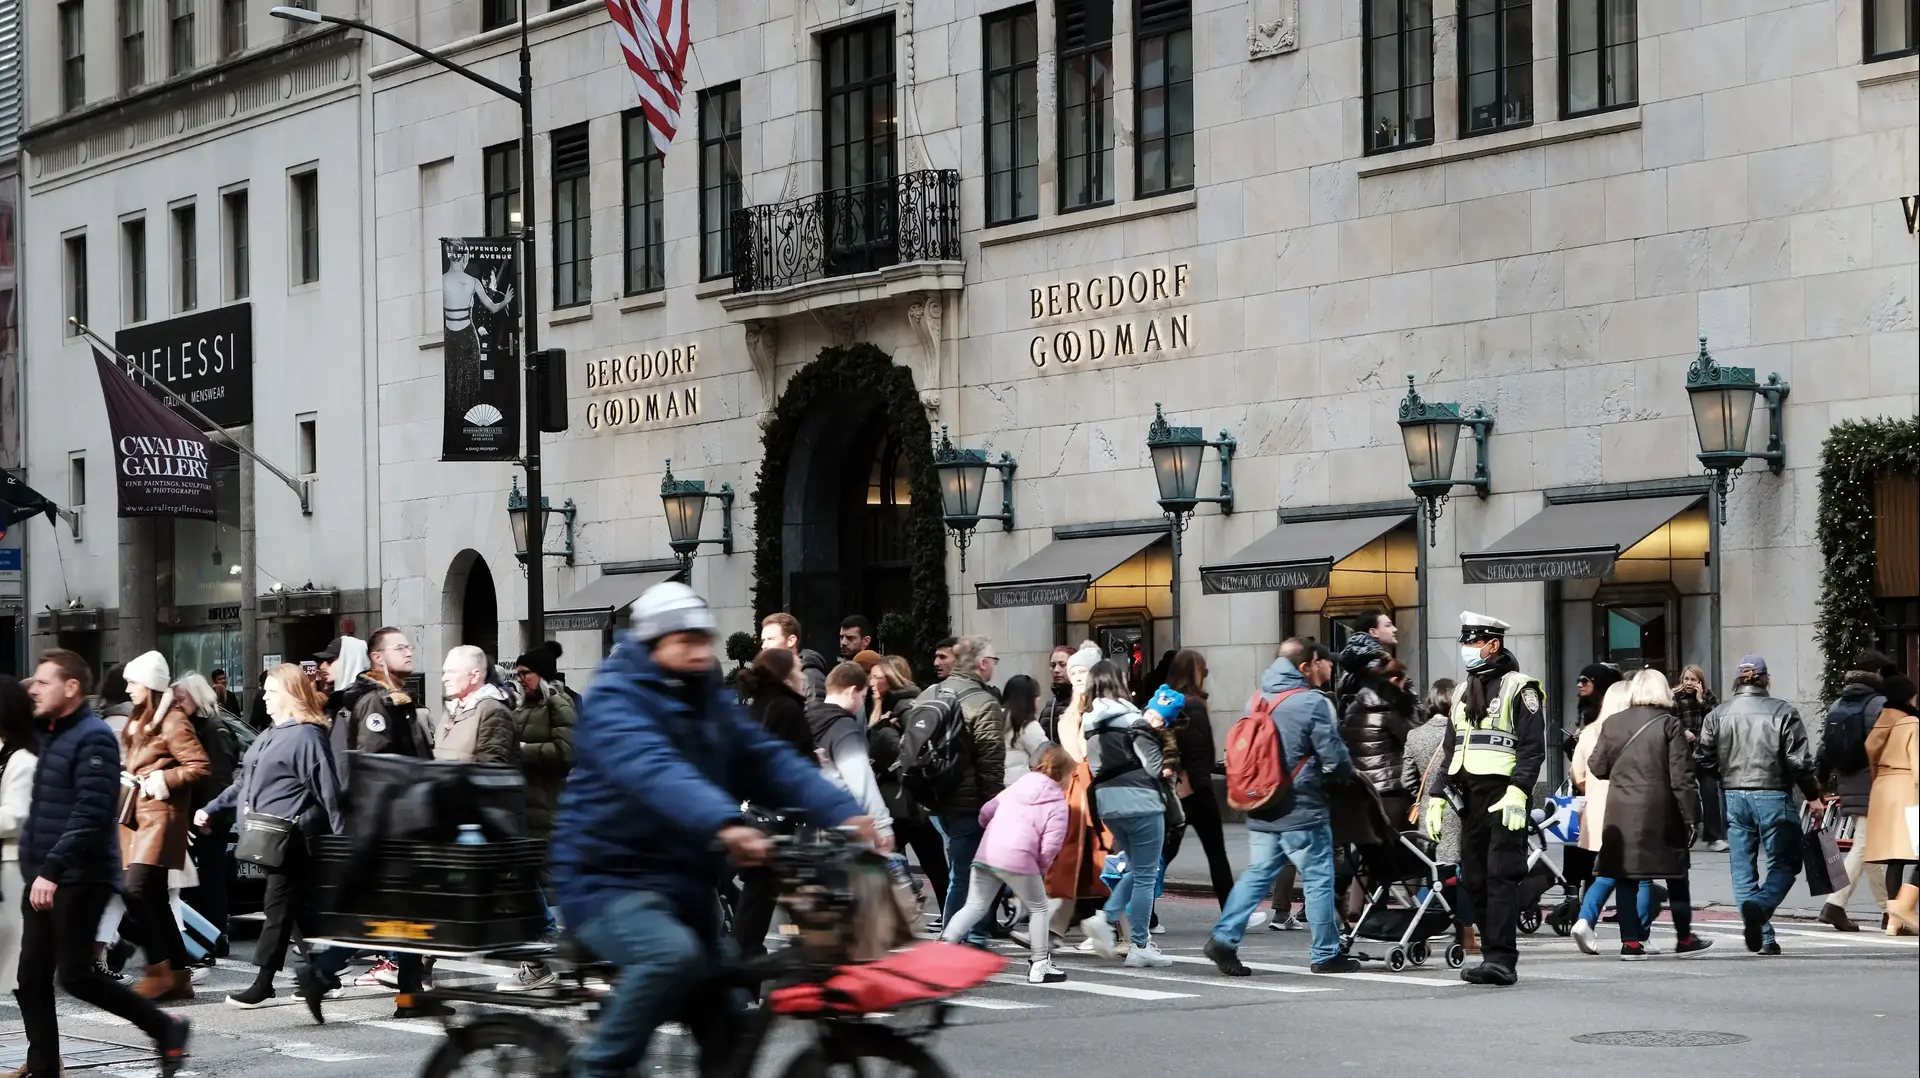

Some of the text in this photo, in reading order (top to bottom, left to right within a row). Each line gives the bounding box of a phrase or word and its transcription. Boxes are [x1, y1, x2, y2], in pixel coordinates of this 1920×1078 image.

[1030, 264, 1188, 319] BERGDORF
[1030, 315, 1188, 367] GOODMAN
[126, 333, 234, 387] RIFLESSI
[586, 345, 697, 389] BERGDORF
[190, 386, 225, 404] MENSWEAR
[586, 387, 697, 430] GOODMAN
[120, 436, 208, 460] CAVALIER
[122, 457, 208, 479] GALLERY
[144, 480, 180, 488] PAINTINGS,
[181, 481, 212, 491] SCULPTURE
[153, 487, 201, 495] PHOTOGRAPHY
[125, 504, 214, 515] www.cavaliergalleries.com
[1487, 560, 1591, 580] BERGDORF GOODMAN
[1221, 572, 1309, 590] BERGDORF GOODMAN
[993, 588, 1069, 605] BERGDORF GOODMAN
[1490, 735, 1514, 747] PD
